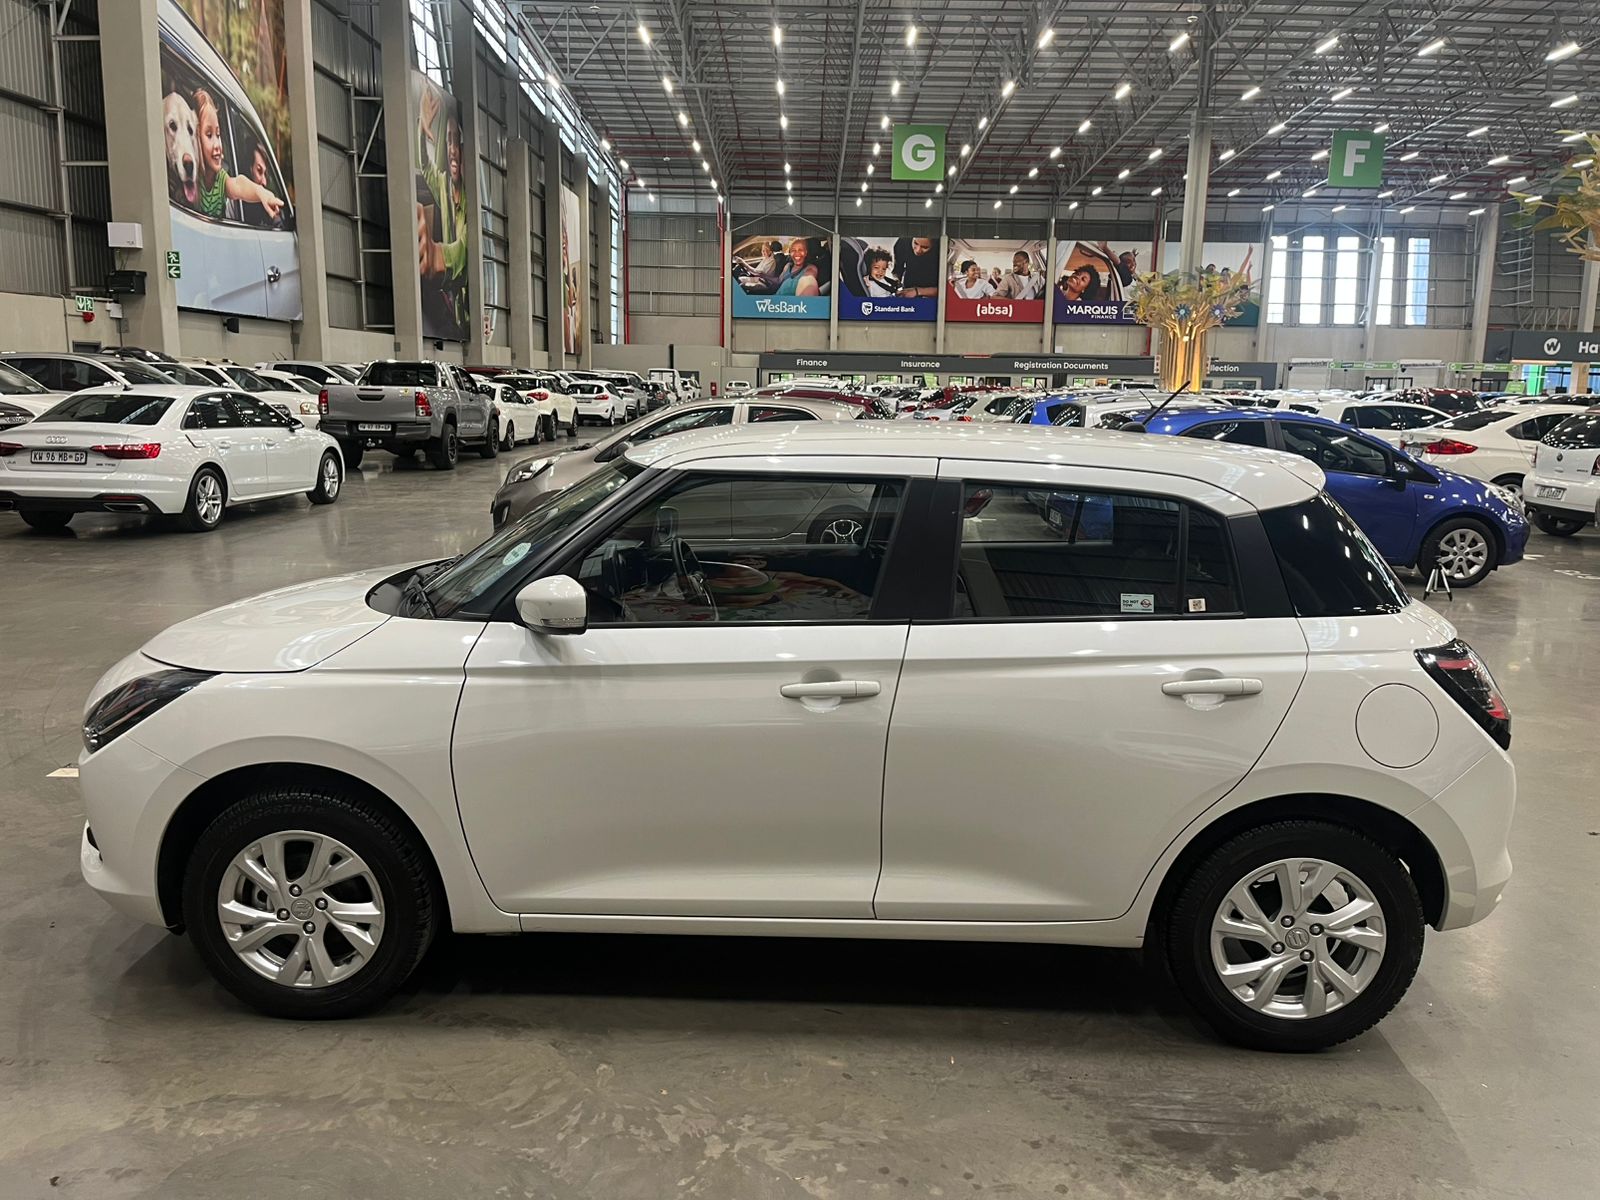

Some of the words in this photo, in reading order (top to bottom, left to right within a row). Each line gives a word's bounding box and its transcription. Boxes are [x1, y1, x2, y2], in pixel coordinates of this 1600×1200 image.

[902, 134, 936, 171] G
[1343, 140, 1371, 176] F
[755, 299, 808, 313] WesBank
[976, 303, 1013, 318] (absa)
[1066, 305, 1118, 315] MARQUIS
[1578, 341, 1600, 354] Ha
[796, 358, 828, 367] Finance
[901, 360, 941, 368] Insurance
[1014, 361, 1062, 371] Registration
[1063, 362, 1109, 370] Documents
[1210, 364, 1240, 372] llection
[33, 452, 43, 461] KW
[46, 452, 56, 461] 96
[58, 453, 69, 462] MB
[74, 453, 85, 462] GP
